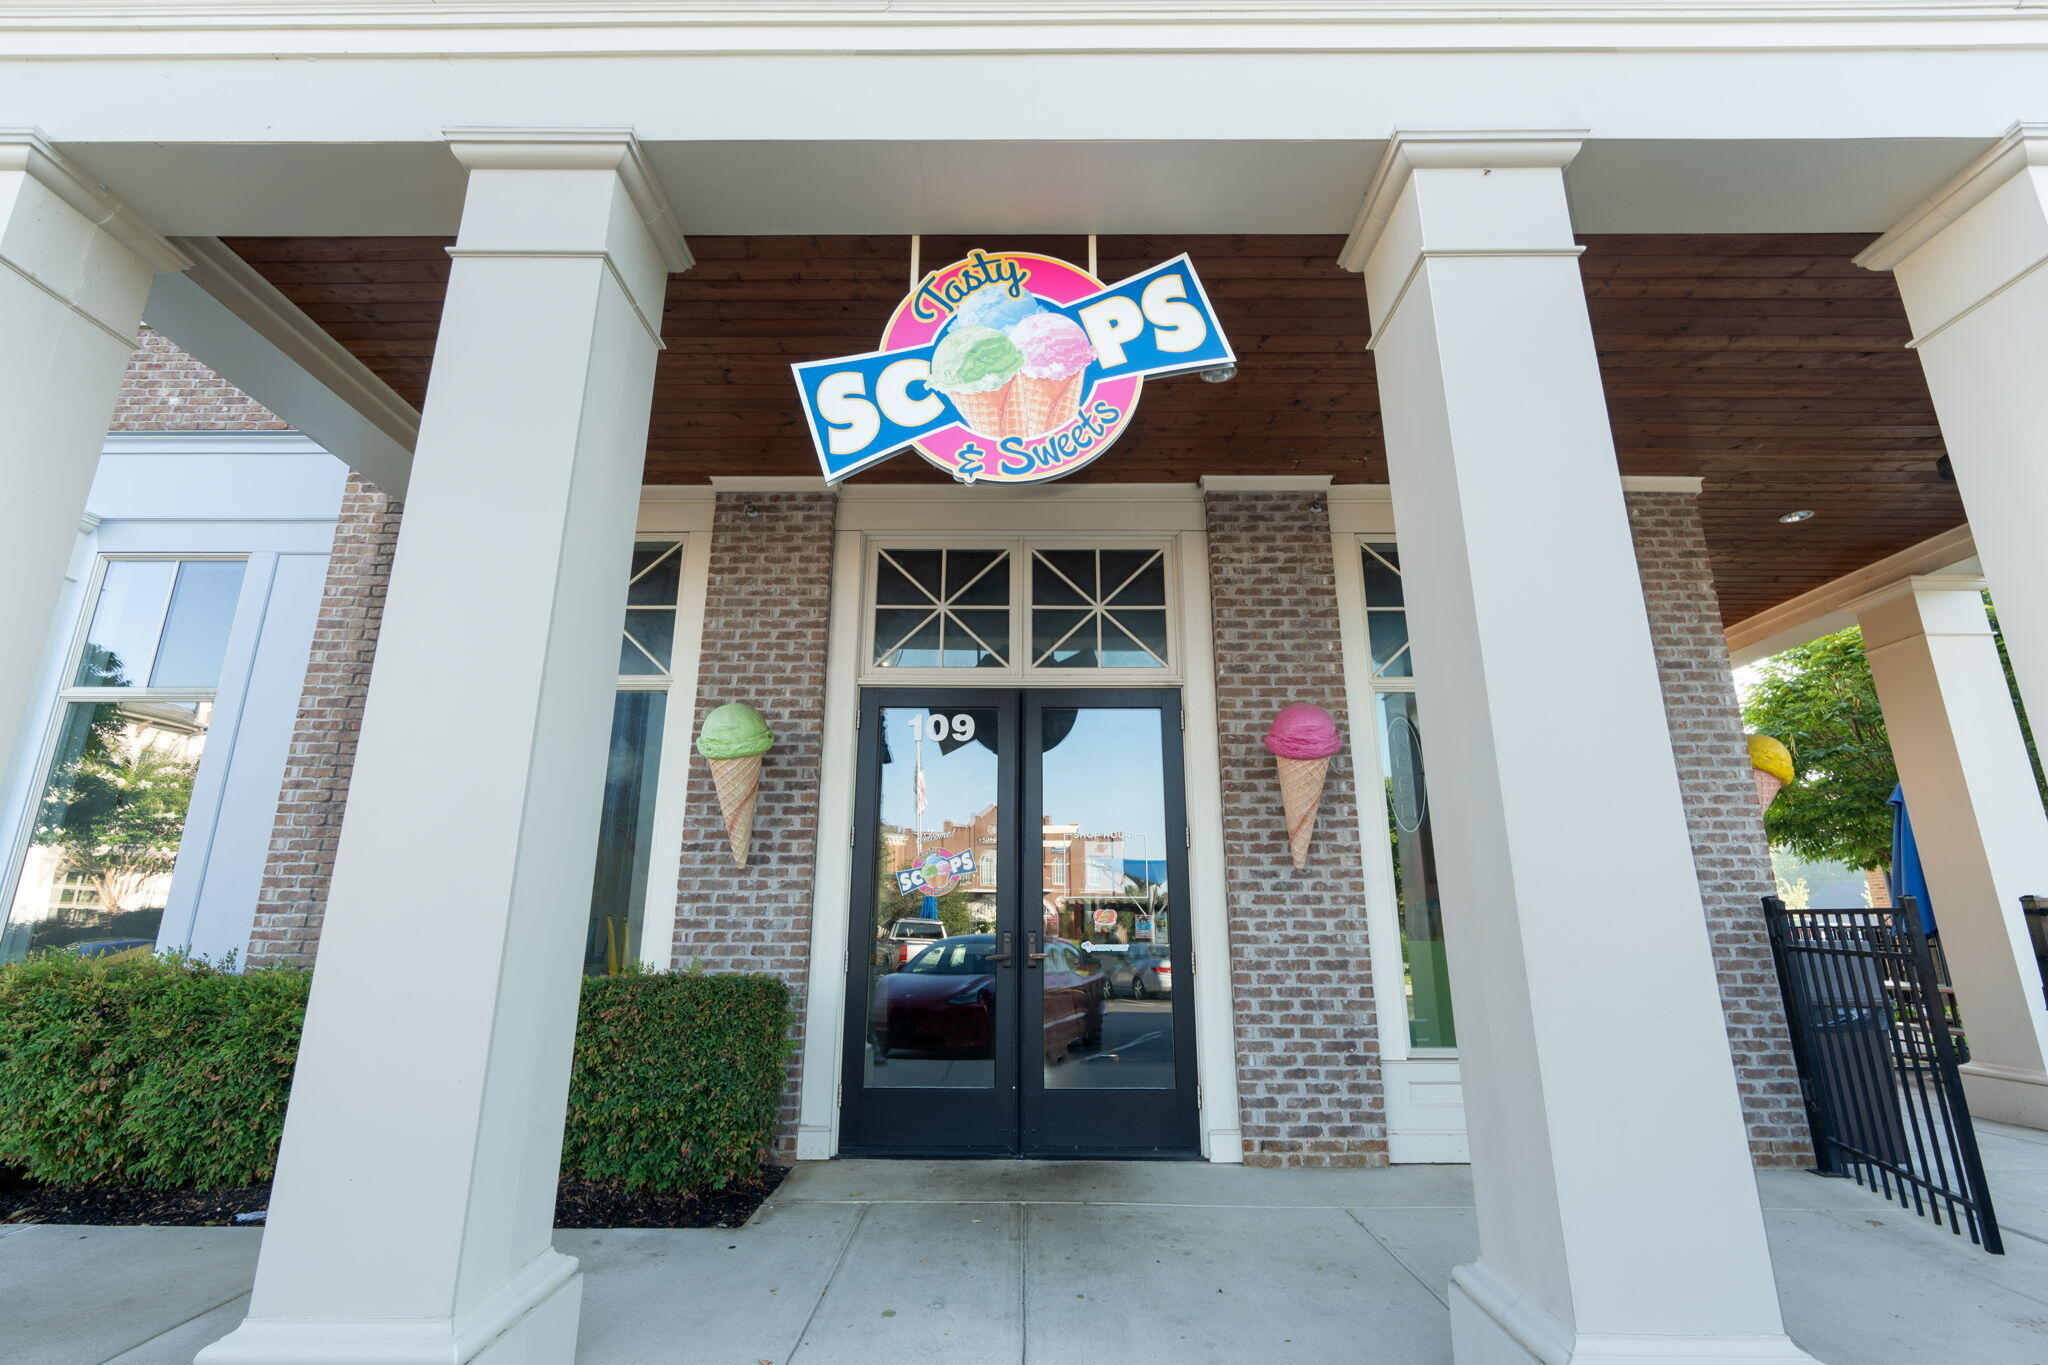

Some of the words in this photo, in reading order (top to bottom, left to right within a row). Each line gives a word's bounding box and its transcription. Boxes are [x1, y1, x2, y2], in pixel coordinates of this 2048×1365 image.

[913, 252, 1030, 321] Tasty
[957, 443, 984, 477] &
[999, 400, 1121, 475] Sweets
[907, 713, 976, 742] 109
[1073, 831, 1100, 840] SHOP
[1103, 831, 1137, 840] HOURS
